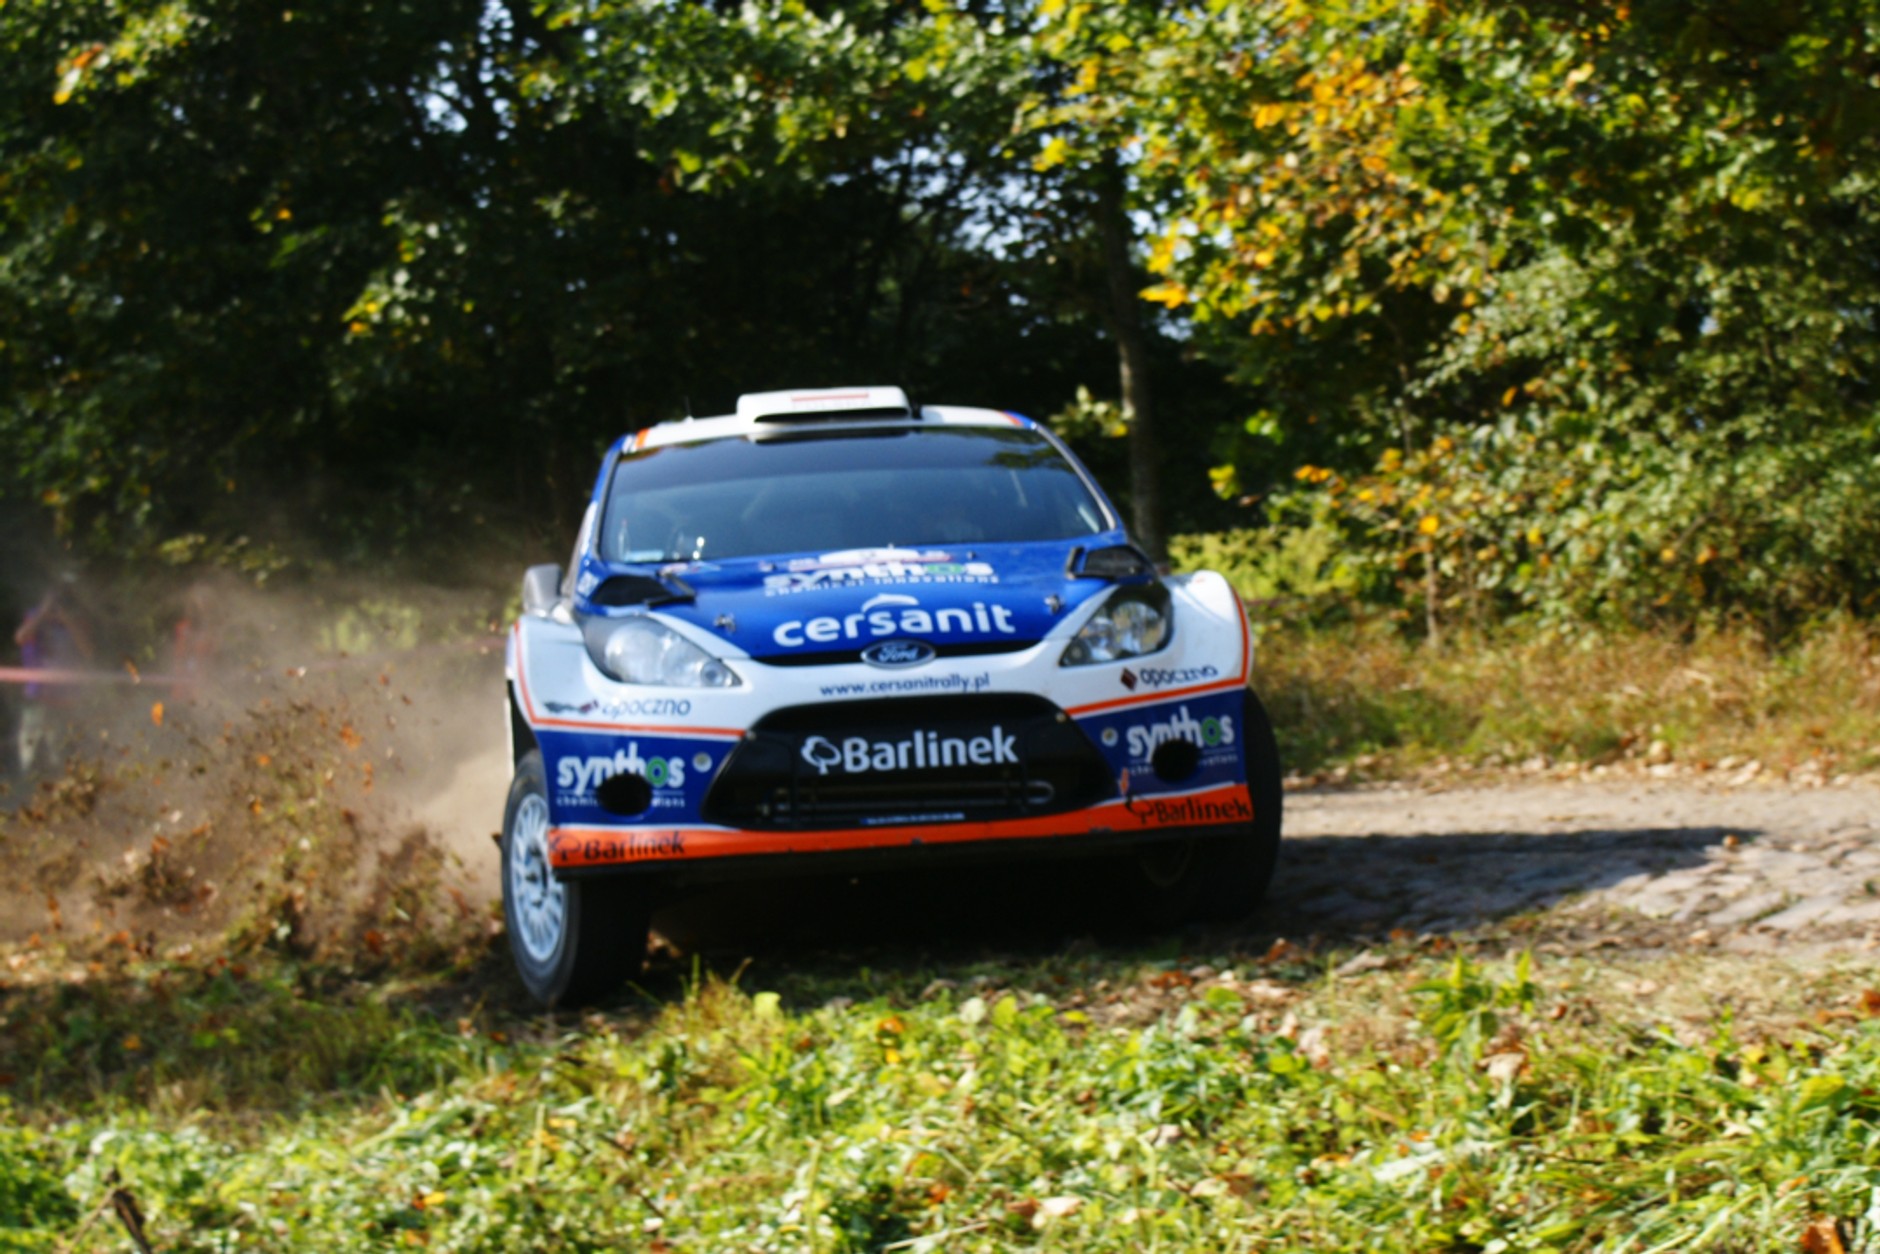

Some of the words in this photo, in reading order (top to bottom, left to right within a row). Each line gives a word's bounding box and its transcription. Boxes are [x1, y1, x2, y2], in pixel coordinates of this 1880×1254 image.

[764, 562, 993, 589] synthos
[773, 602, 1016, 646] cersanit
[877, 642, 919, 663] Ford
[819, 673, 990, 696] www.cersanitrally.pl
[1140, 665, 1218, 687] opoczno
[843, 725, 1019, 772] Barlinek
[1154, 798, 1250, 823] Barlinek
[584, 831, 686, 860] Barlinek
